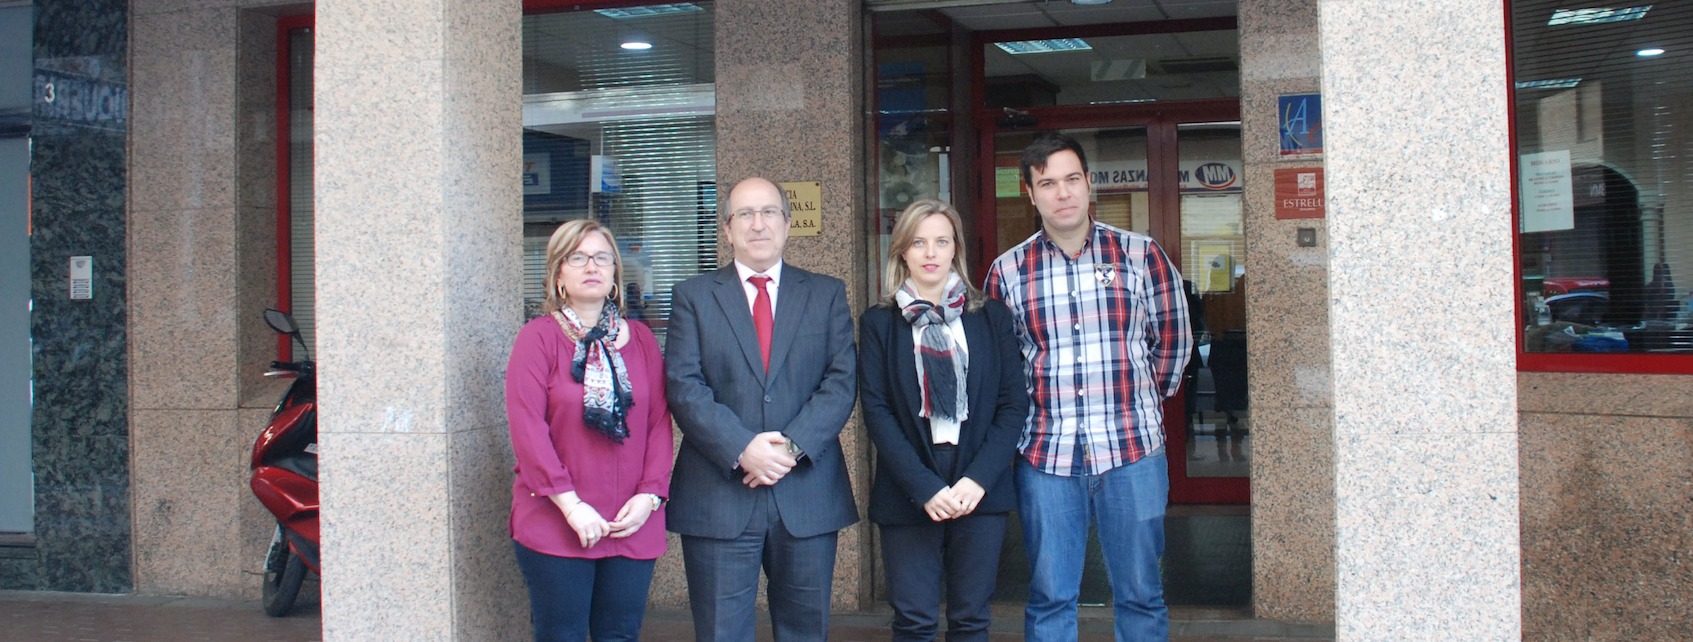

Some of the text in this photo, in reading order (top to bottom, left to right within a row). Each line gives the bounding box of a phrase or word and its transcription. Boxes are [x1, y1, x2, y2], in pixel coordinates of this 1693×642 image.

[44, 82, 56, 103] 3
[786, 190, 797, 199] CIA
[790, 201, 803, 212] INA,
[1283, 198, 1325, 208] ESTRELL
[790, 220, 802, 229] LA,
